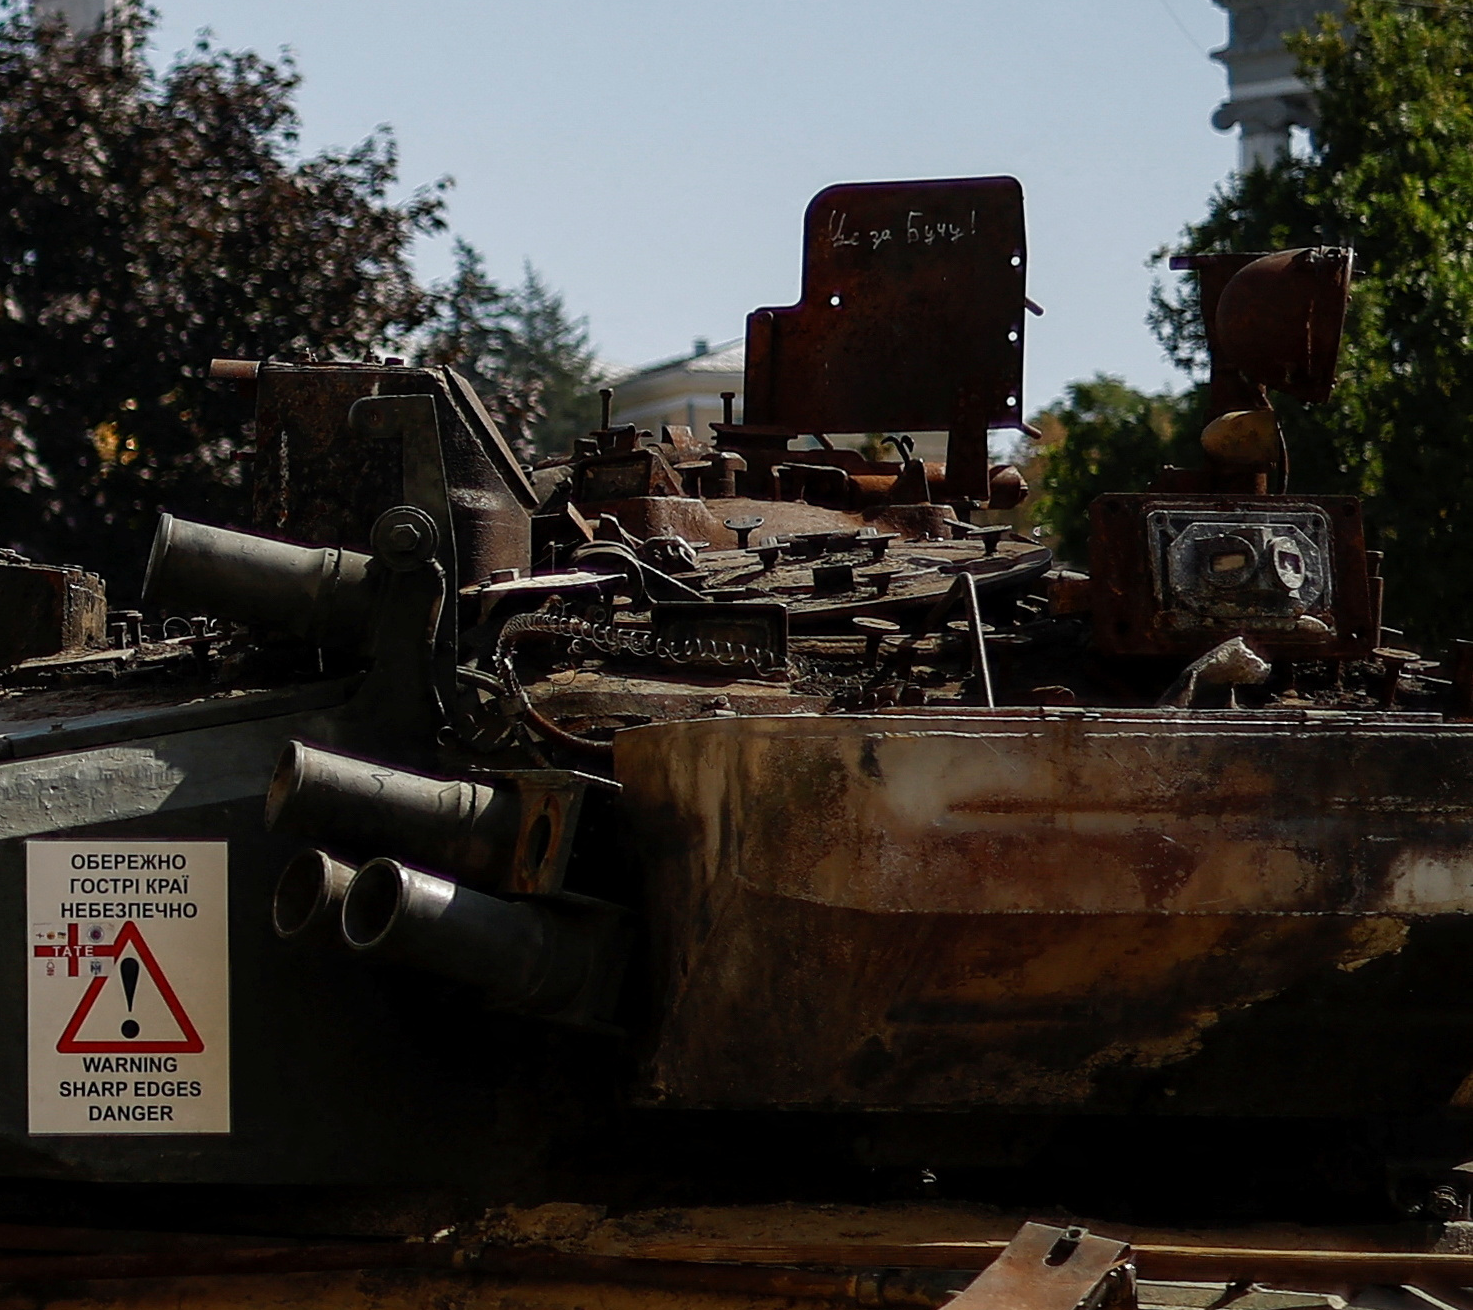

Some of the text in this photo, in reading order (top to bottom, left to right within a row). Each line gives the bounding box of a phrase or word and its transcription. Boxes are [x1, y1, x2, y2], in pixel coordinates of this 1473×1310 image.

[70, 853, 187, 871] ОБЕРЕЖНО
[70, 875, 189, 895] ГОСТРІ КРАЇ
[60, 902, 198, 919] НЕБЕЗПЕЧНО
[52, 945, 94, 957] TATE
[82, 1056, 178, 1073] WARNING
[59, 1081, 202, 1098] SHARP EDGES
[88, 1105, 174, 1122] DANGER
